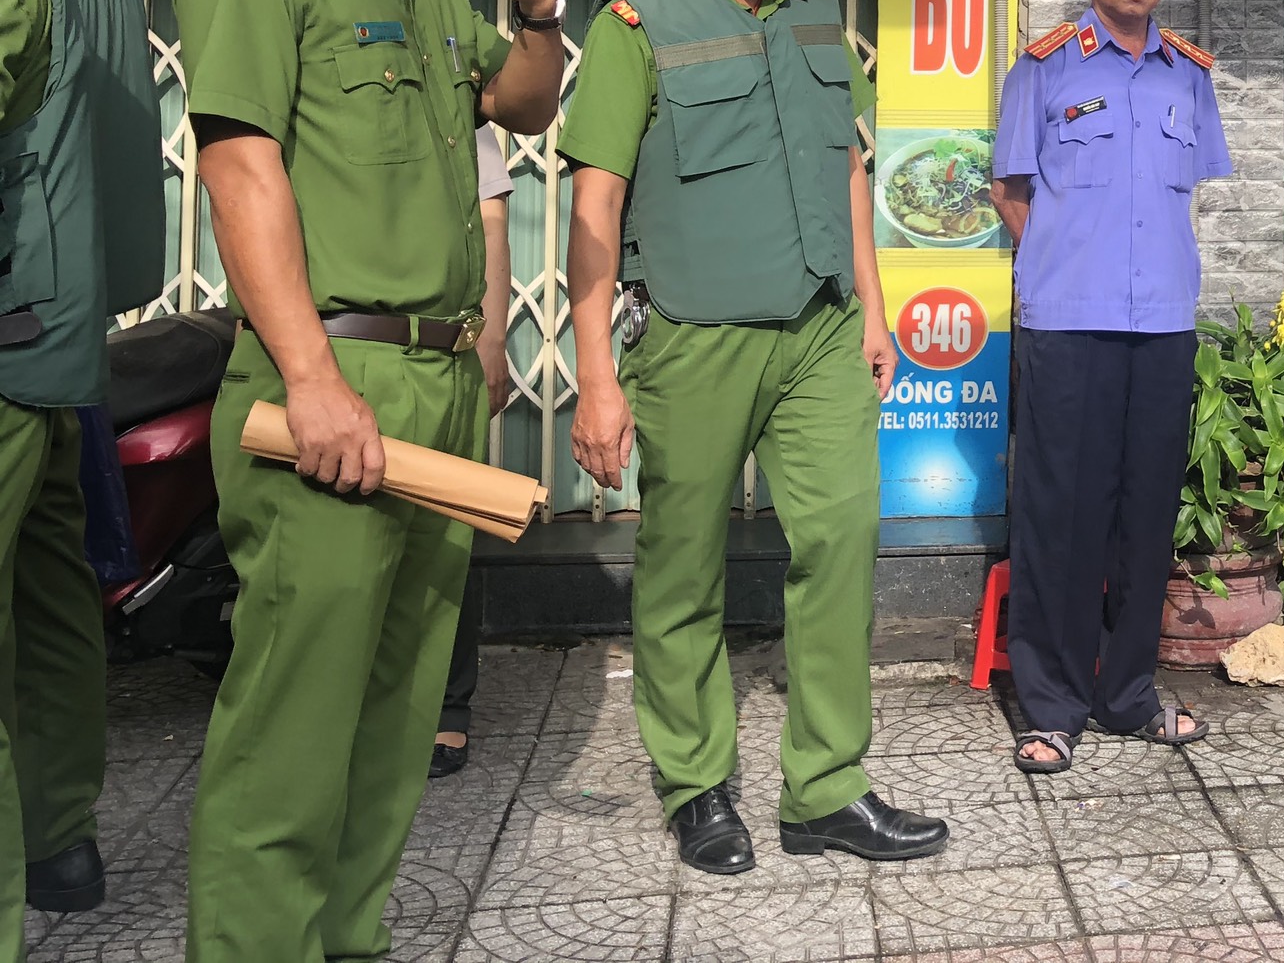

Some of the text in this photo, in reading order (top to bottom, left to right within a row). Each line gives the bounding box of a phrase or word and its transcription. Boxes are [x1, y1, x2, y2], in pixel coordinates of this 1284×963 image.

[911, 302, 972, 353] 346
[961, 381, 998, 403] ĐA
[877, 411, 999, 429] TEL: 0511.3531212
